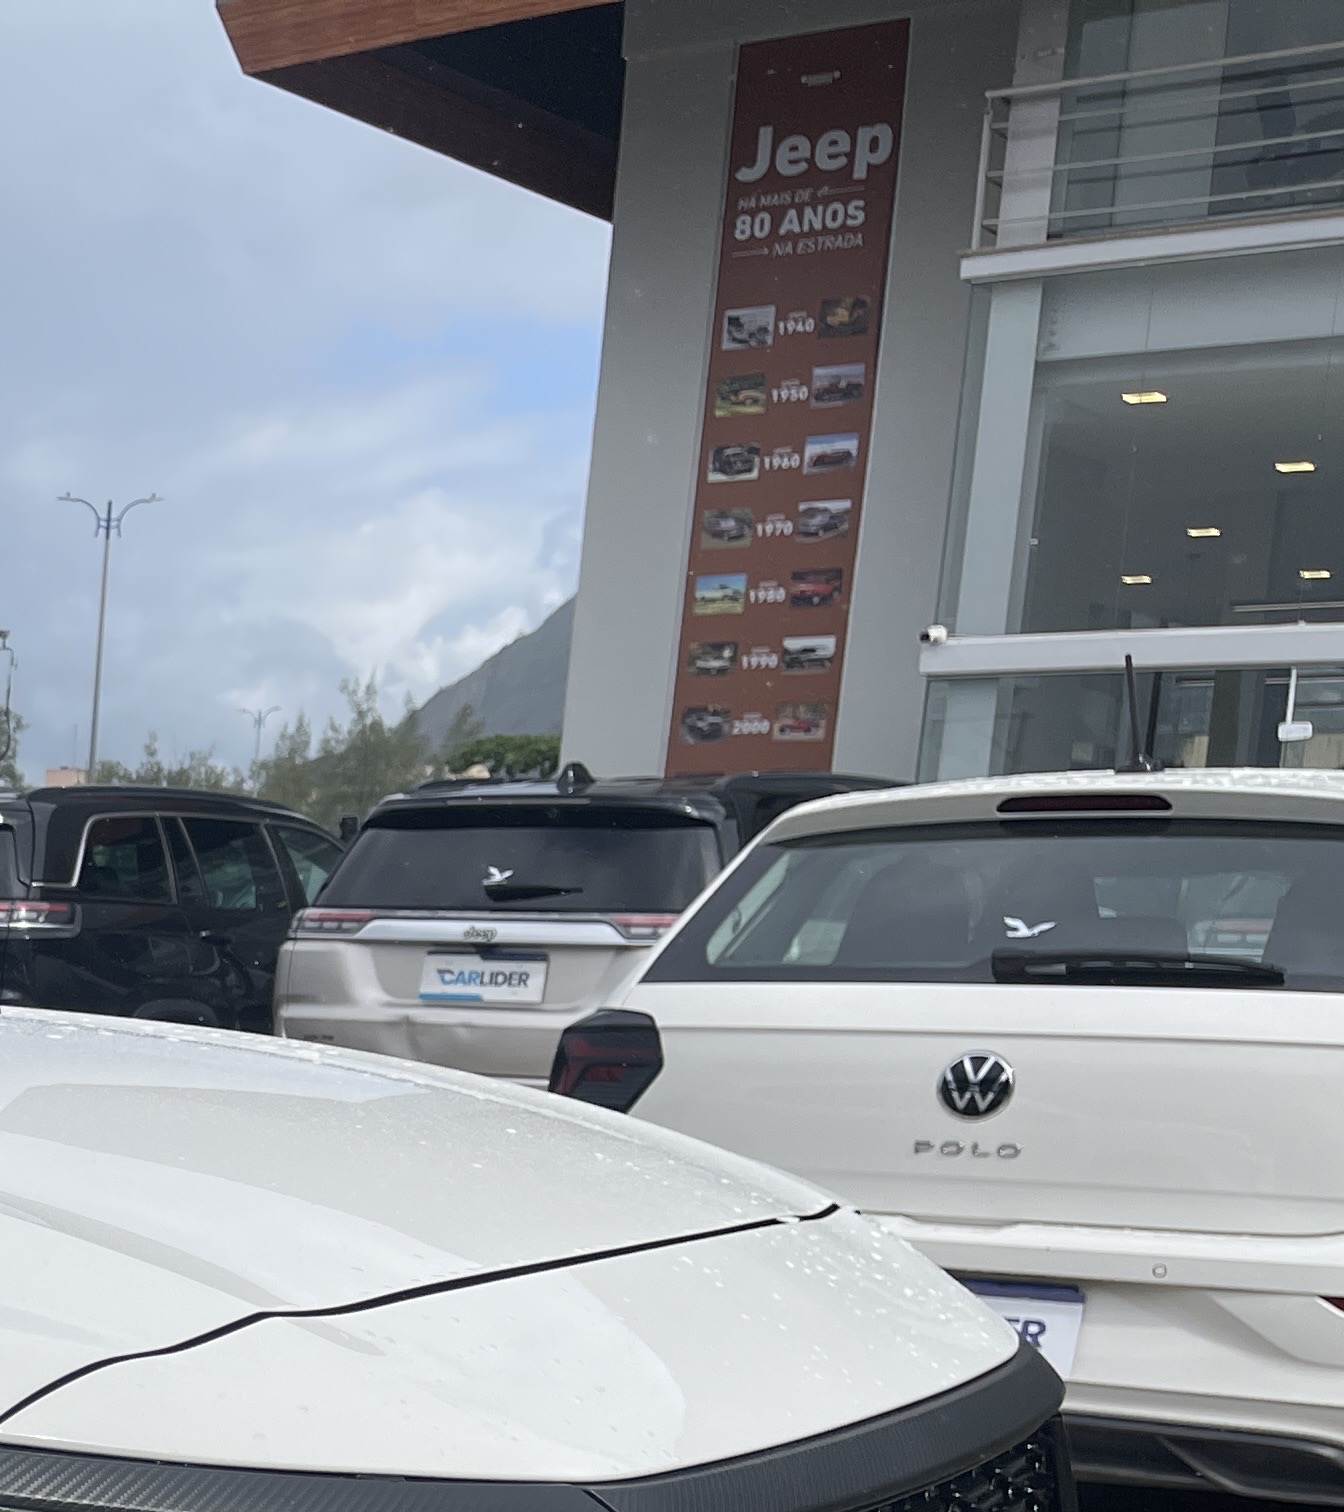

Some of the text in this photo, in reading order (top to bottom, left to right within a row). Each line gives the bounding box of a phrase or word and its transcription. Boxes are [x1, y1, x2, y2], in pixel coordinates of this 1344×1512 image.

[735, 122, 893, 183] Jeep
[733, 199, 866, 241] 80 ANOS
[796, 232, 864, 255] ESTRADA
[436, 967, 531, 988] CARLIDER
[914, 1139, 1023, 1159] POLO
